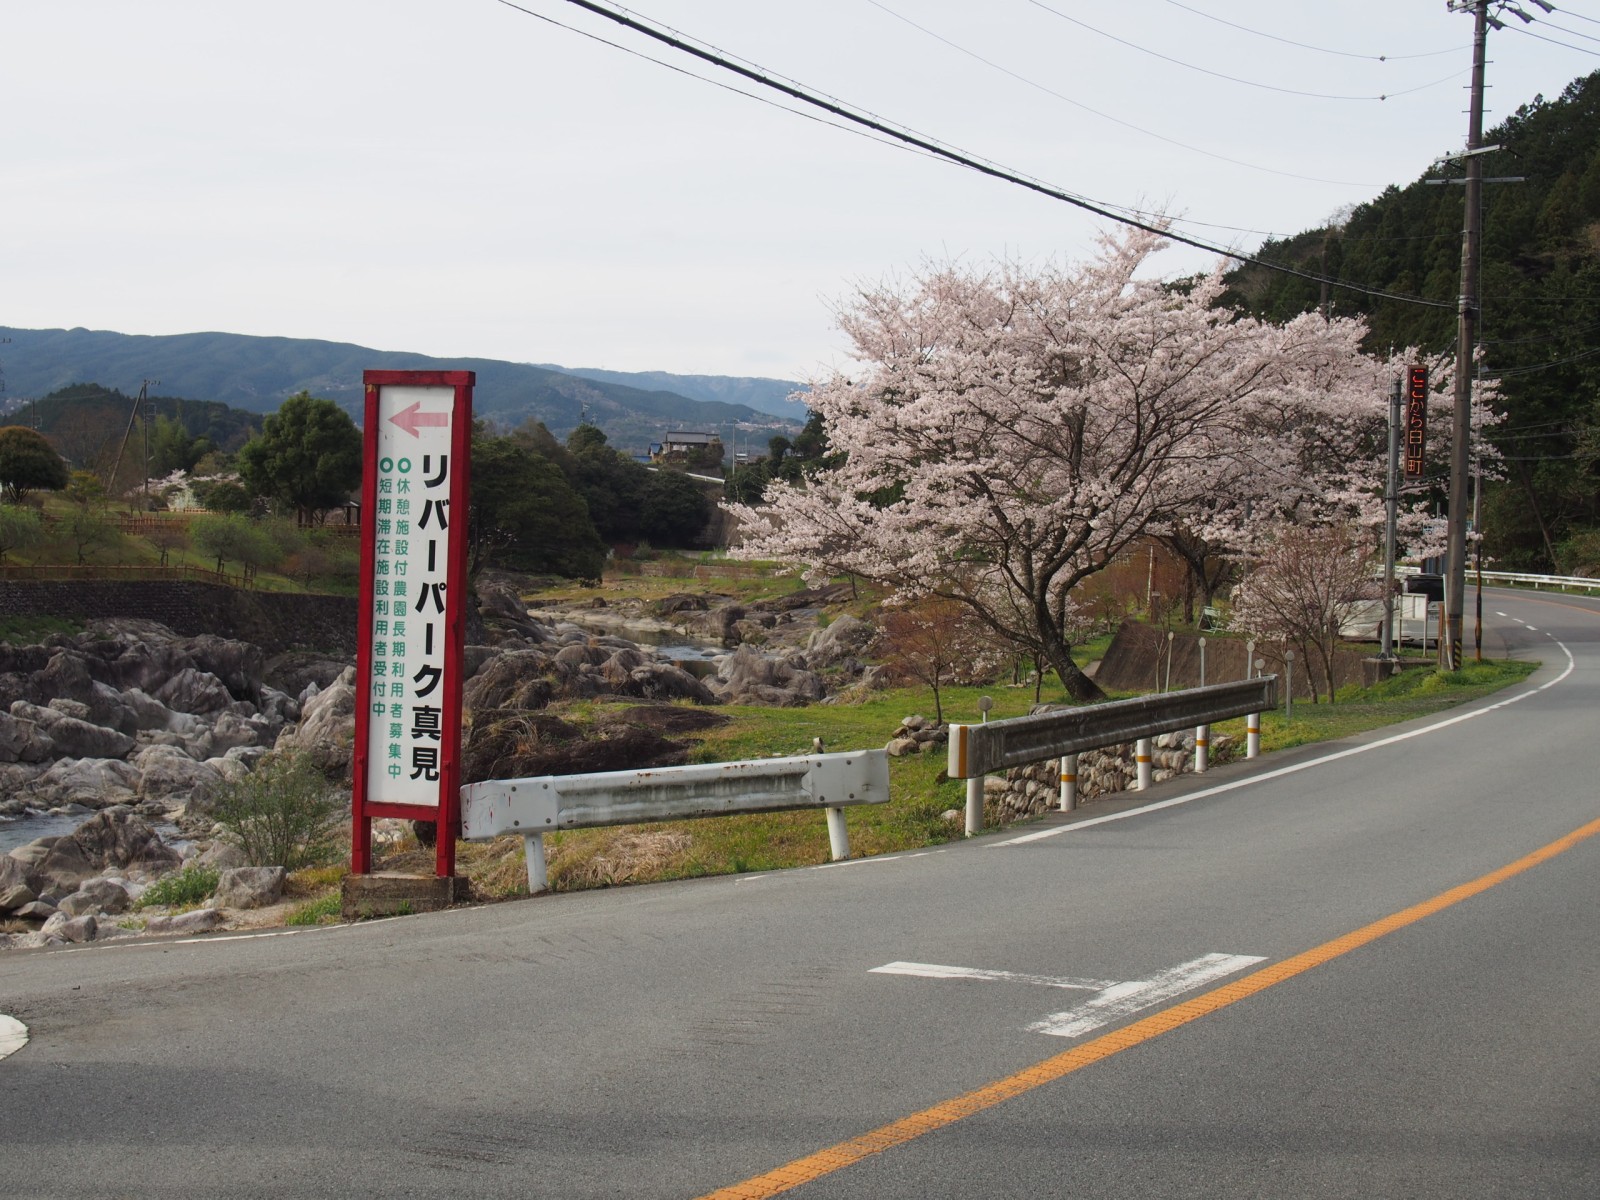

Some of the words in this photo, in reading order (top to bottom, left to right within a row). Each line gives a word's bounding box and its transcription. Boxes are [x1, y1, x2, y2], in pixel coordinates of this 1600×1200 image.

[410, 454, 450, 781] リバーパーク真見
